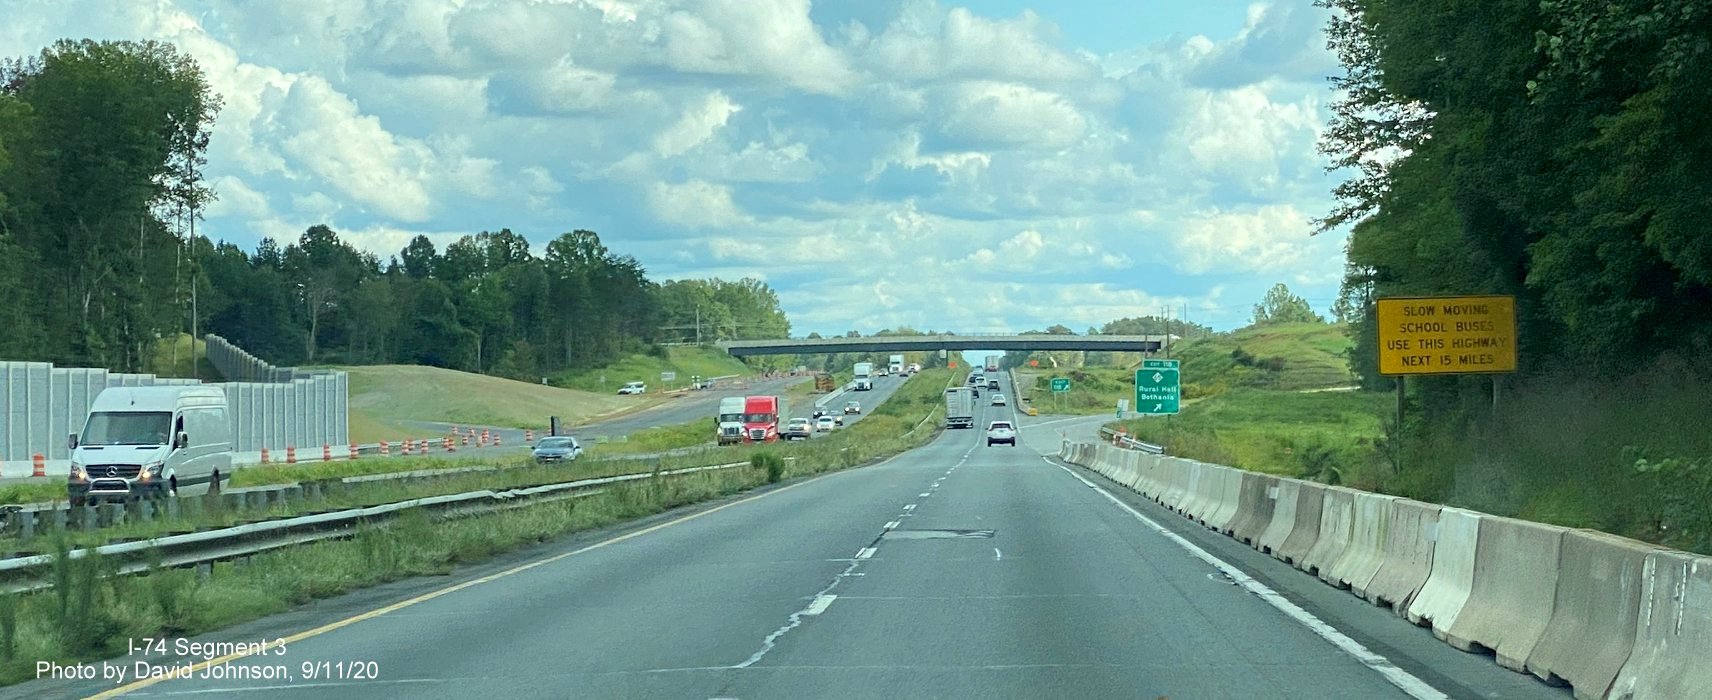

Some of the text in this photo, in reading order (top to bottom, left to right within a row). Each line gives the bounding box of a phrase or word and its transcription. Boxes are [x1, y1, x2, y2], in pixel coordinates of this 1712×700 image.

[1404, 304, 1488, 317] SLOW MOVING
[1400, 322, 1494, 333] SCHOOL BUSES
[1388, 338, 1507, 350] USE THIS HIGHWAY
[1402, 354, 1494, 366] NEXT 15 MILES
